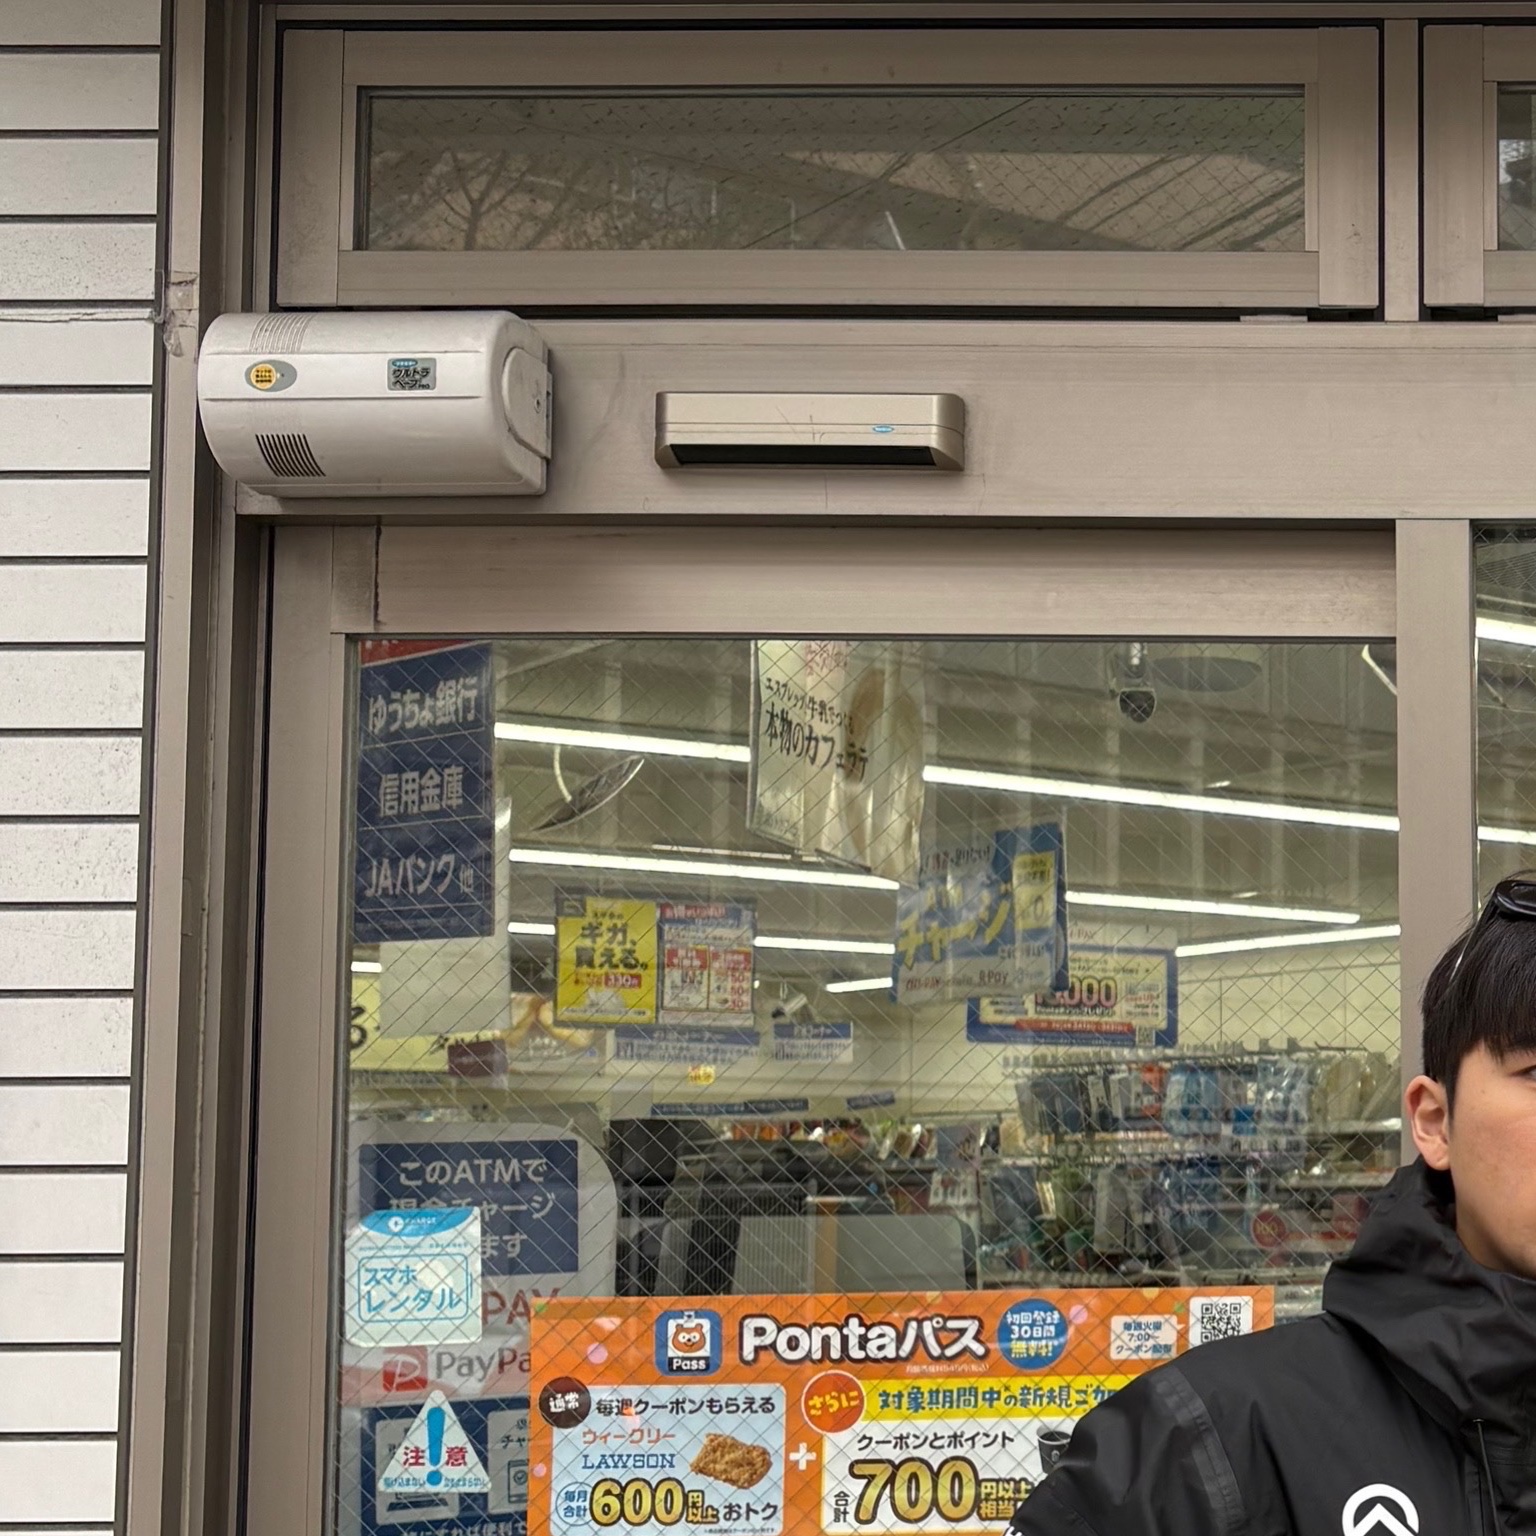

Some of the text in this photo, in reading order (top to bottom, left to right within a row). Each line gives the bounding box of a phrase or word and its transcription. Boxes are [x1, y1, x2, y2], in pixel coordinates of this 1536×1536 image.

[368, 676, 478, 734] ゆうちょ銀行
[378, 766, 465, 817] 信用金庫
[399, 1157, 549, 1186] このATMで
[364, 1265, 417, 1286] スマホ
[366, 1287, 462, 1314] レンタル
[1006, 1311, 1060, 1325] 初回登録
[742, 1313, 987, 1364] Pontaパス
[1011, 1326, 1056, 1338] 30日間
[672, 1357, 707, 1372] Pass
[549, 1392, 580, 1413] 通常
[596, 1396, 776, 1417] 毎週クーポンもらえる
[808, 1391, 859, 1417] さらに
[582, 1428, 675, 1446] ウィークリー
[856, 1431, 1014, 1451] クーポンとポイント
[582, 1454, 676, 1470] LAWSON
[564, 1490, 588, 1503] 毎月
[850, 1457, 979, 1525] 700
[564, 1504, 588, 1519] 合計
[590, 1478, 685, 1527] 600
[723, 1502, 779, 1522] おトク
[833, 1491, 851, 1524] 合計
[981, 1501, 1022, 1519] 相当
